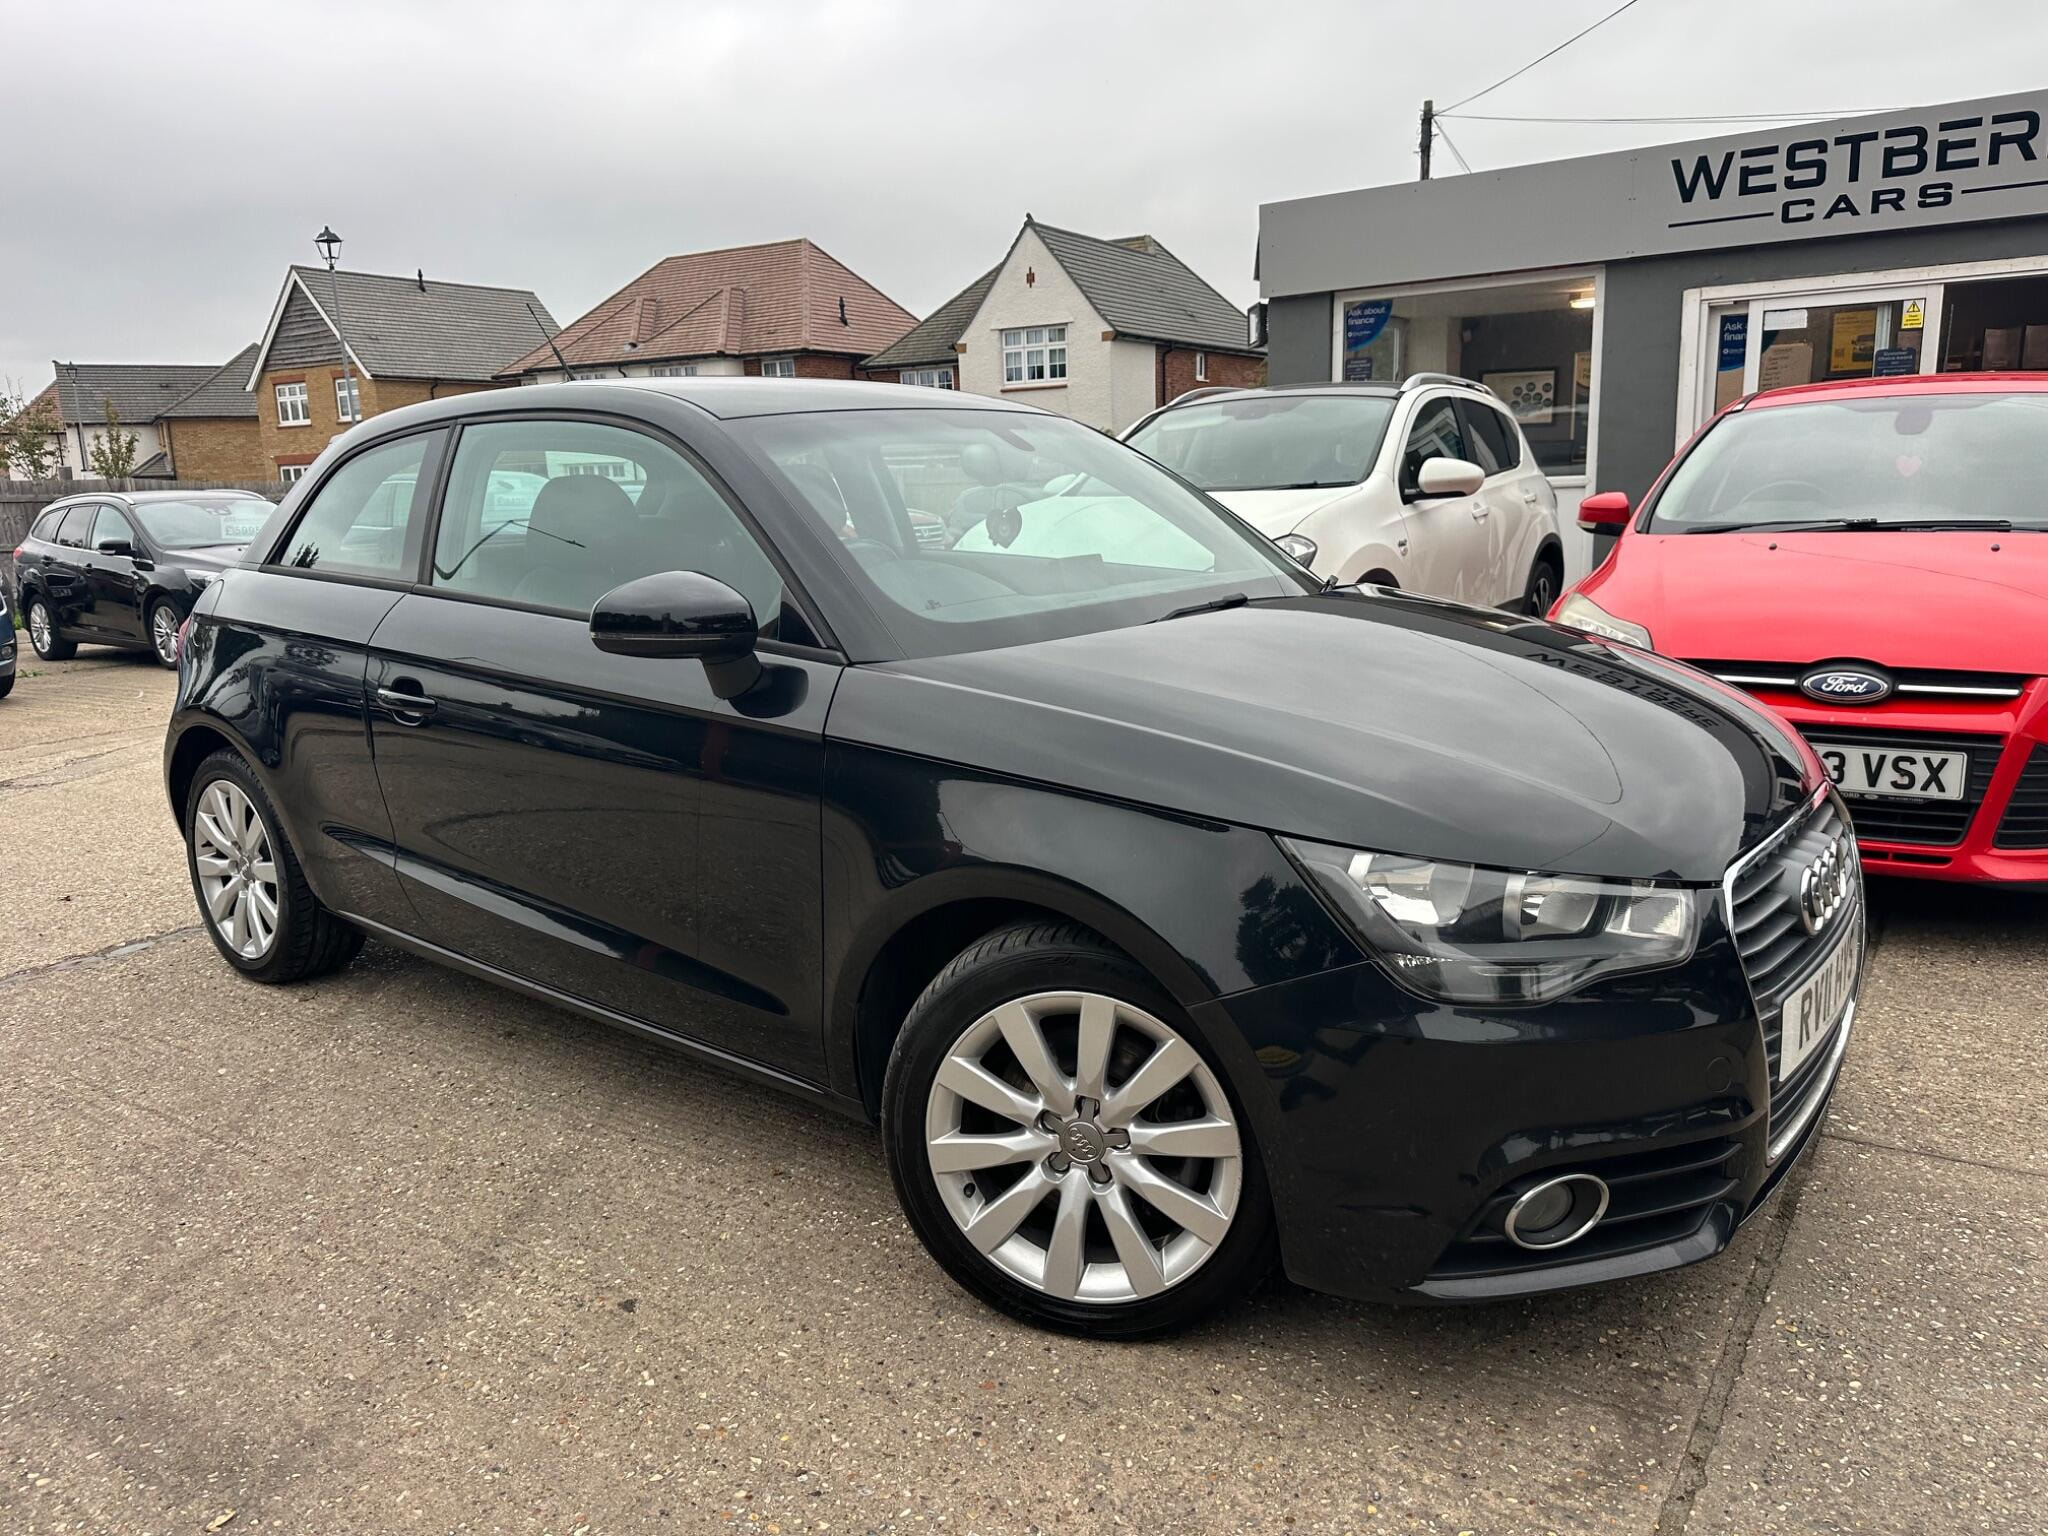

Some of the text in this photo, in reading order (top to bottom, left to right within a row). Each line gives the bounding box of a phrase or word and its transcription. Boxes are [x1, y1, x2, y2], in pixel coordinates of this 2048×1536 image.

[1671, 110, 2048, 204] WESTBER
[1781, 182, 1954, 224] CARS
[1347, 317, 1375, 326] finance
[1348, 306, 1386, 317] Ask about
[1723, 321, 1742, 331] Ask
[1821, 676, 1869, 693] Ford
[1862, 753, 1949, 793] VSX
[1799, 962, 1833, 1050] RV11
